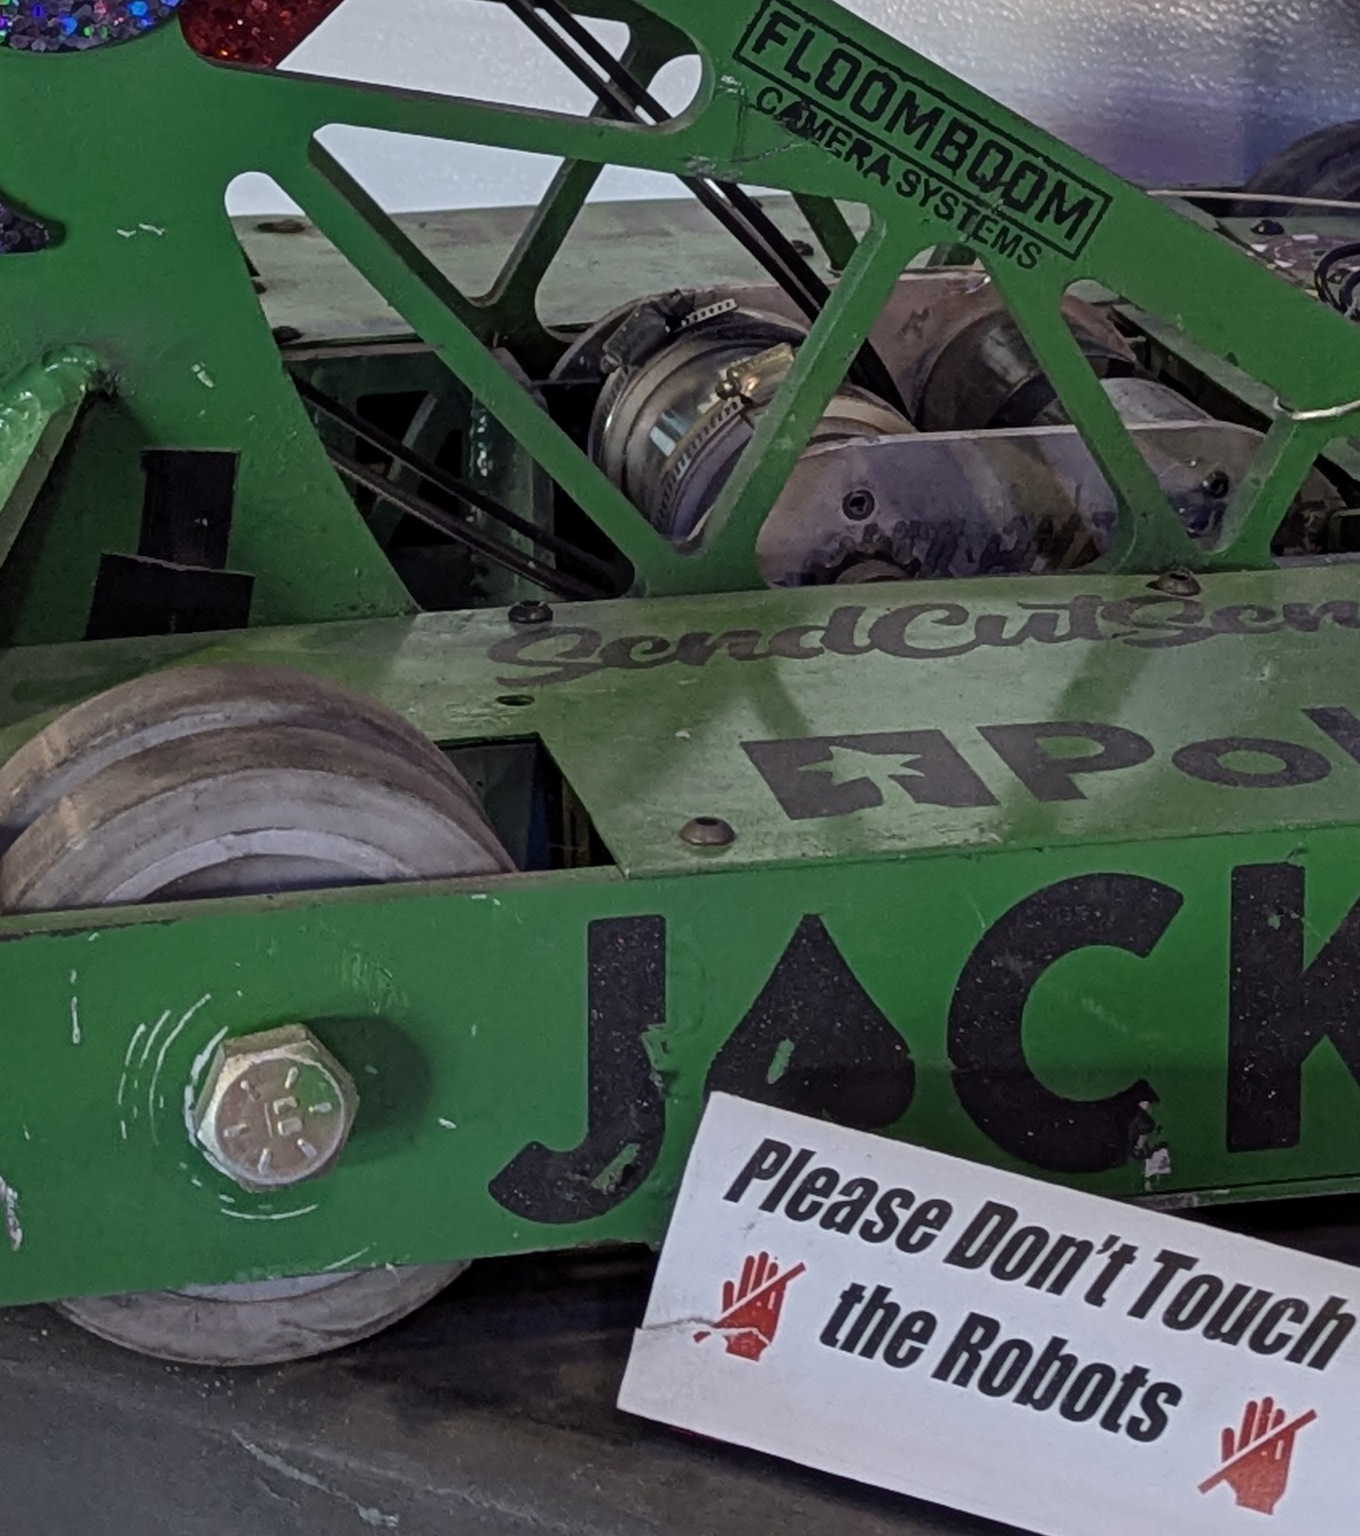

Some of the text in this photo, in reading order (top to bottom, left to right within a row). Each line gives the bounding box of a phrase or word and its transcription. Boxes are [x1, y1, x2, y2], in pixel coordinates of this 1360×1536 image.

[751, 10, 1096, 243] FLOOMBOOM
[754, 85, 1043, 271] CAMERA SYSTEMS
[723, 1138, 1358, 1372] Please Don't Touch
[818, 1281, 1183, 1444] the Robots
